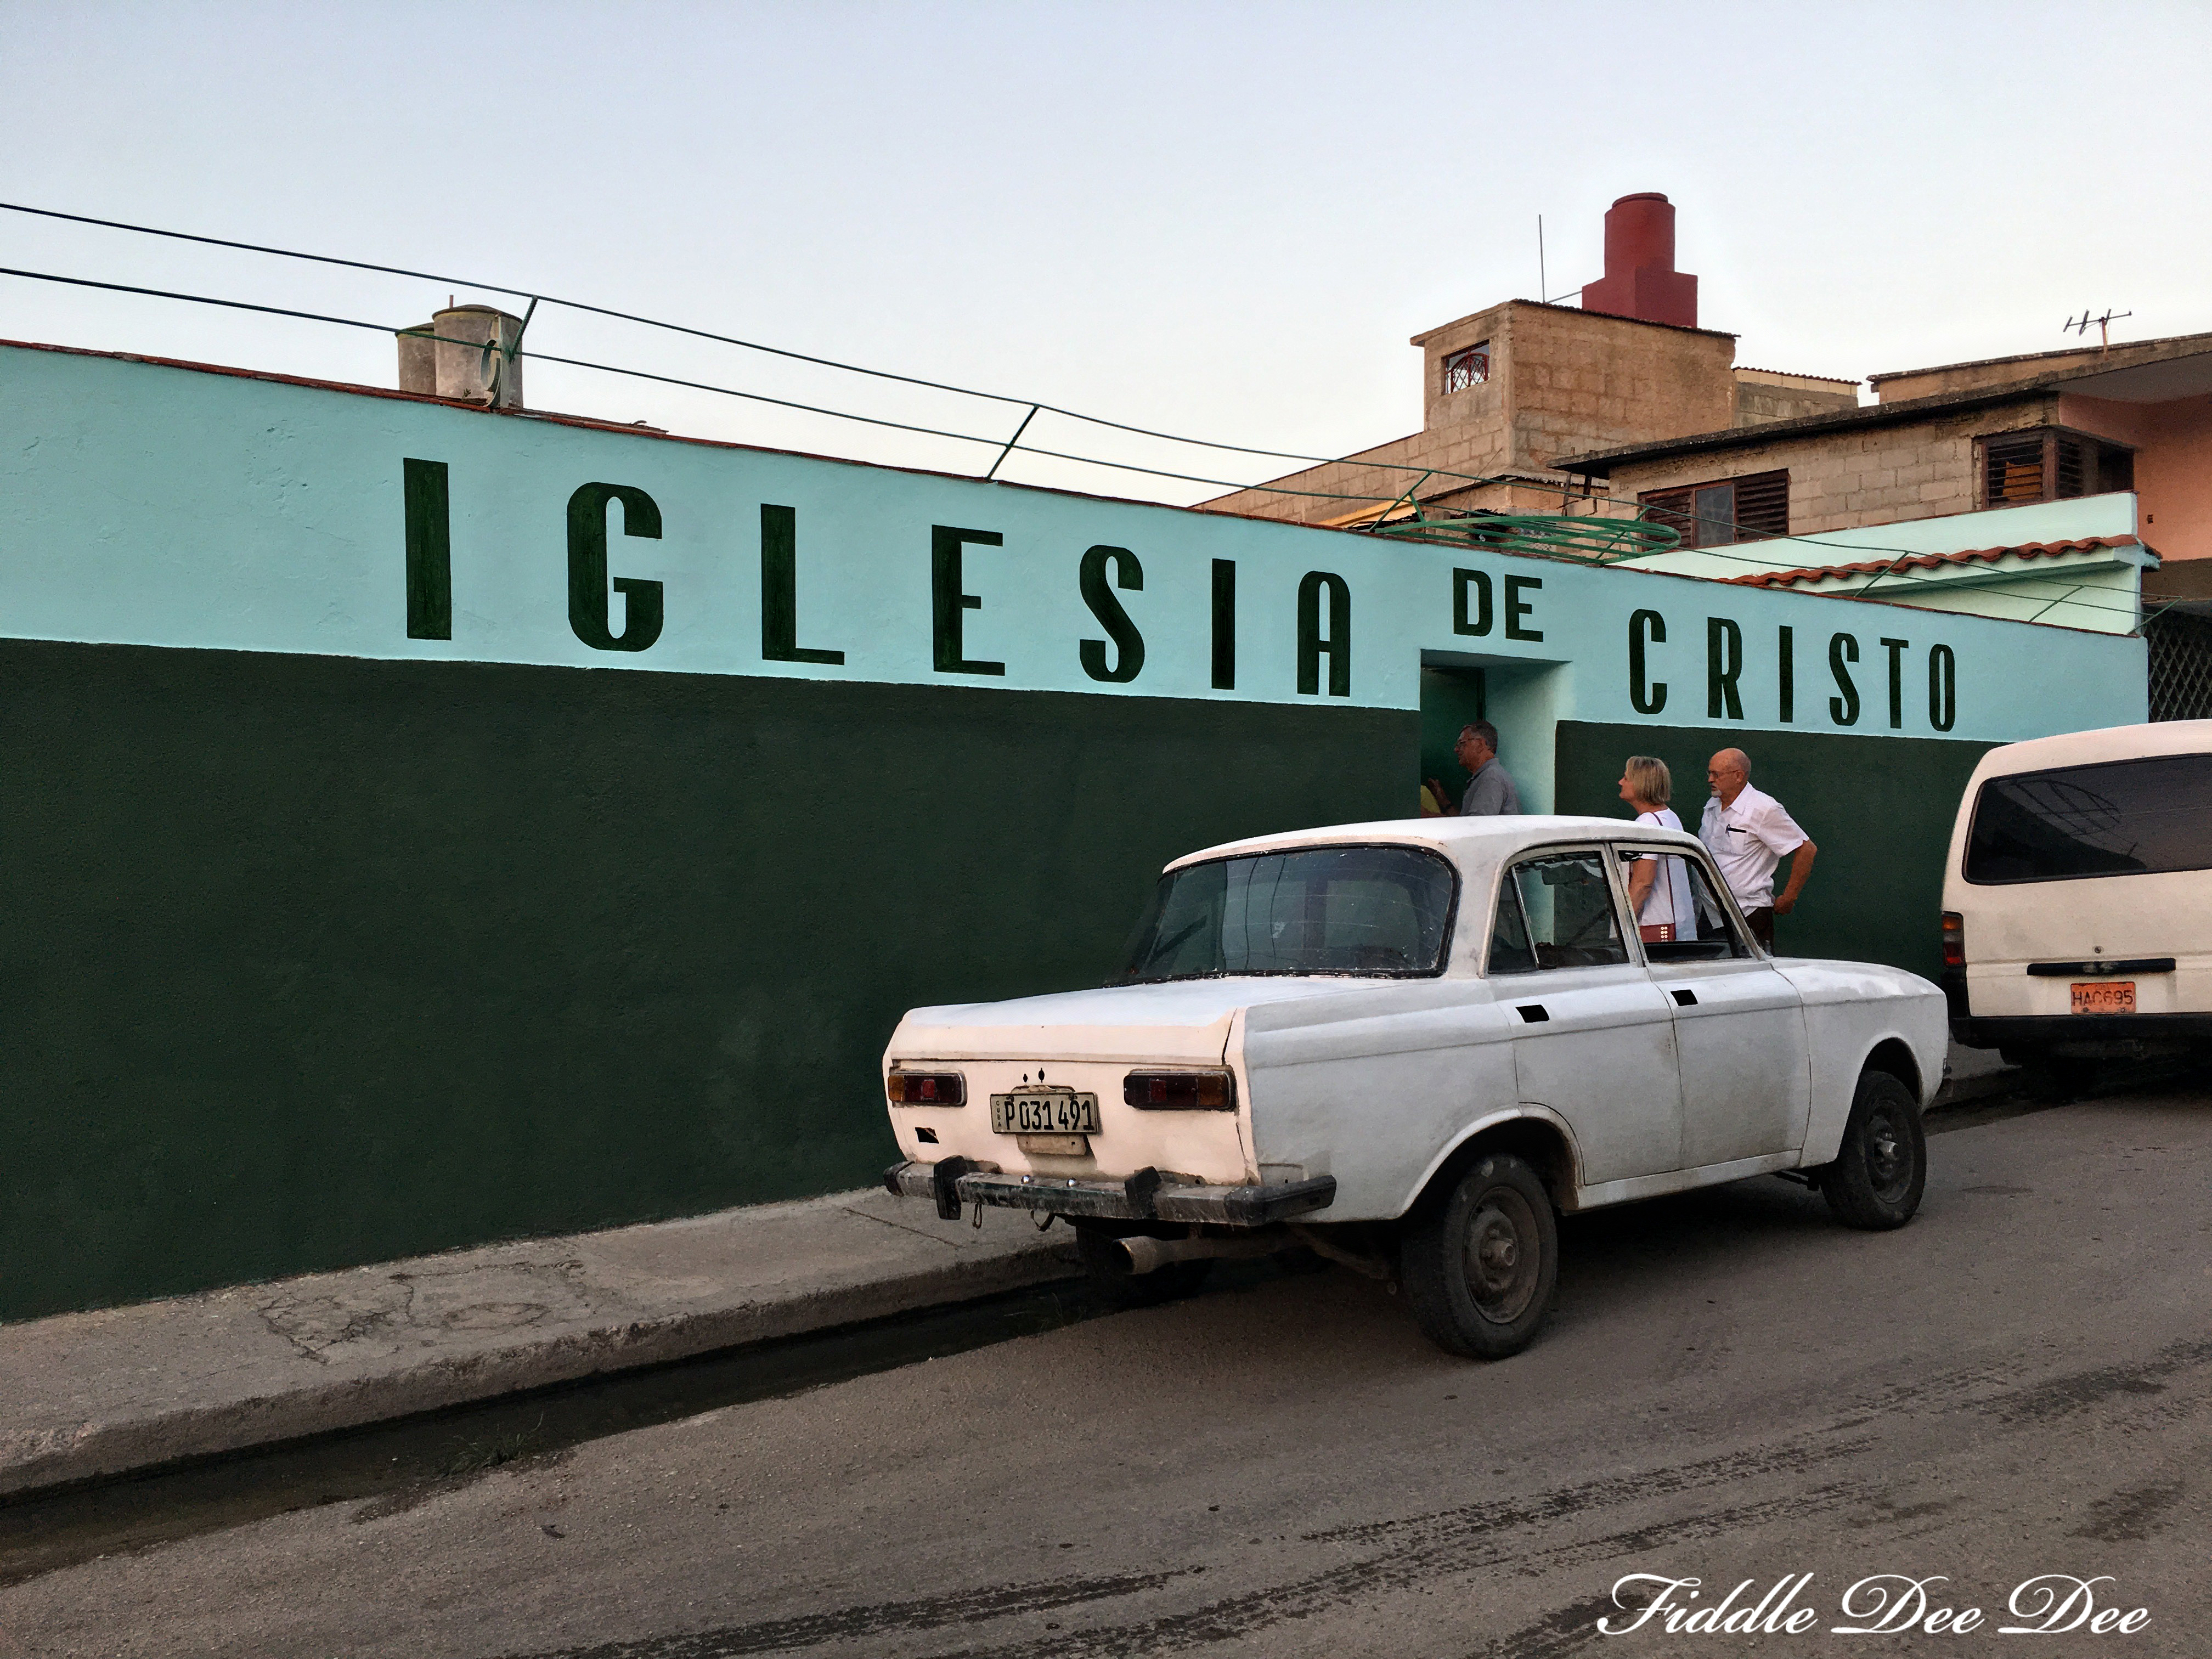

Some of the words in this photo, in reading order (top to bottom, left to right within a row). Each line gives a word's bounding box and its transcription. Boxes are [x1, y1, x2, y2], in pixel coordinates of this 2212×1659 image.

[403, 457, 1351, 697] IGLESIA
[1453, 567, 1544, 642] DE
[1628, 608, 1956, 732] CRISTO
